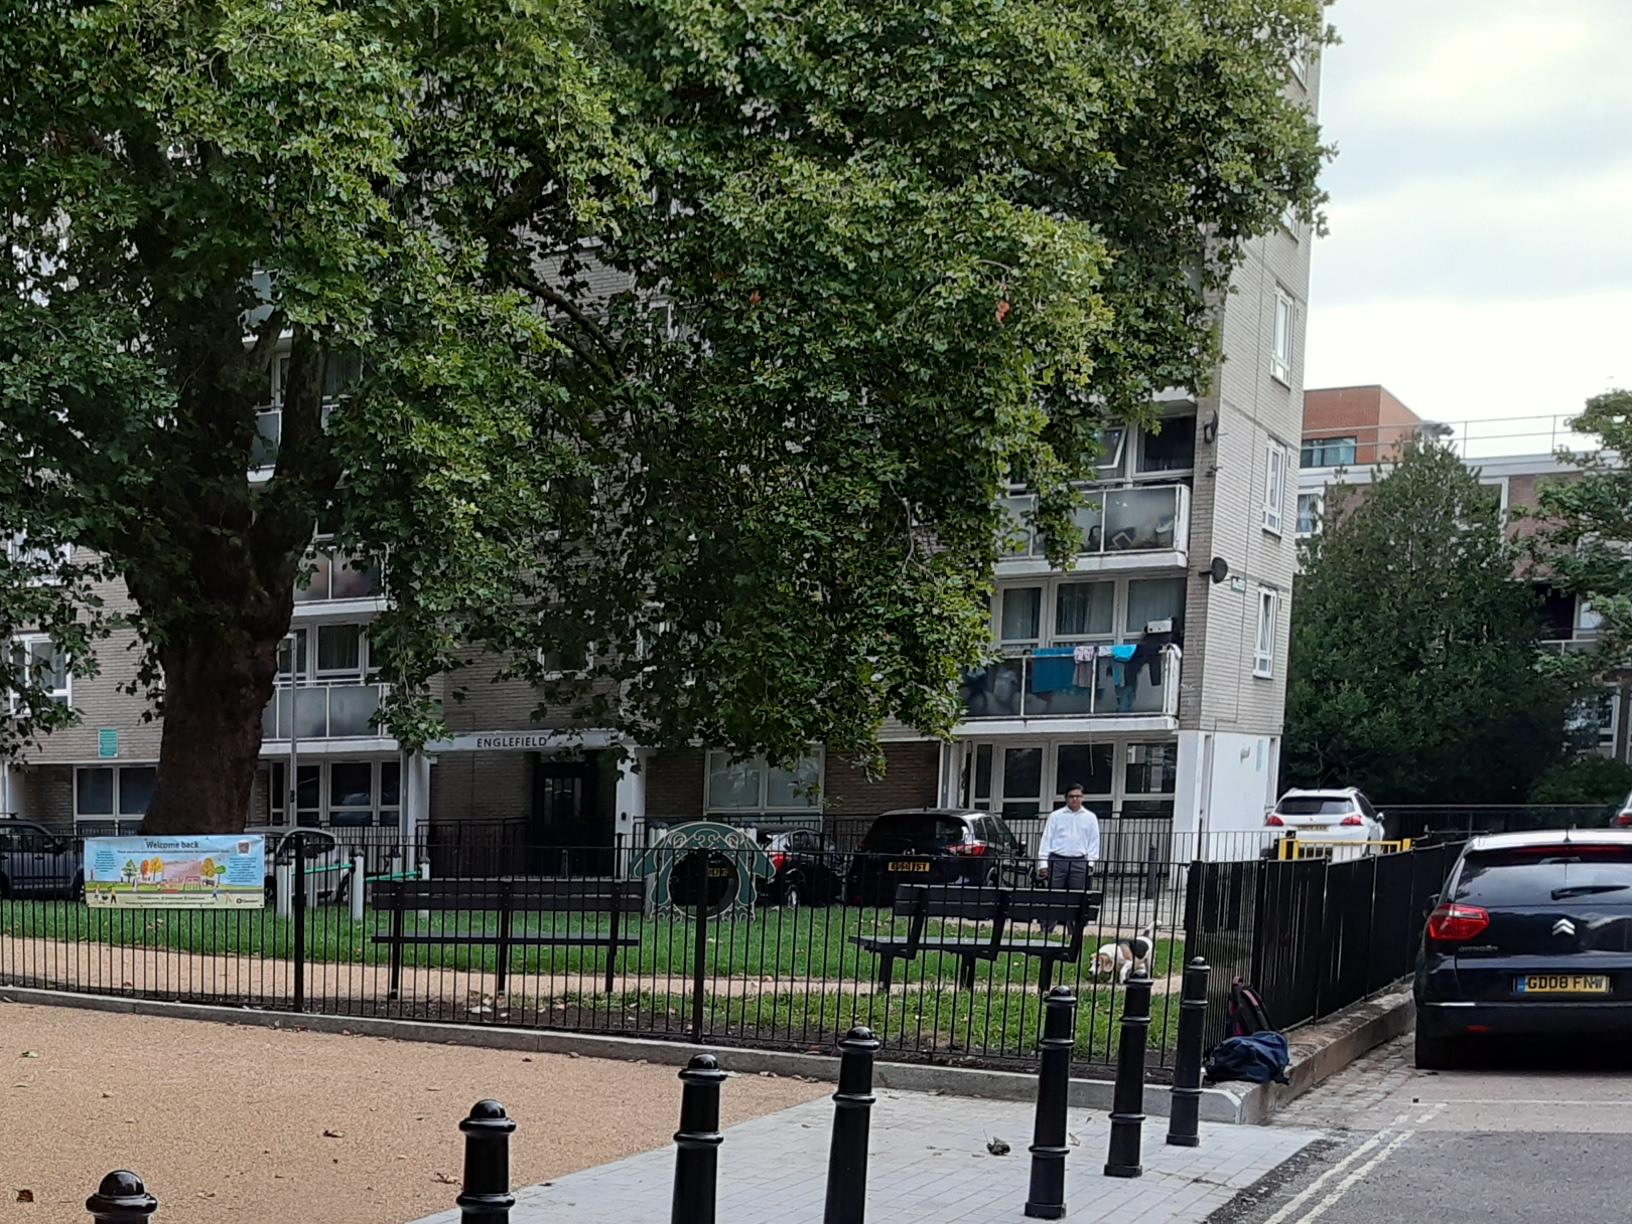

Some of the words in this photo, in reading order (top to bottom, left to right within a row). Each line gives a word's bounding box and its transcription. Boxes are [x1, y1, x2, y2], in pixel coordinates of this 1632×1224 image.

[477, 737, 547, 748] ENGLEFIELD
[146, 841, 180, 849] Welcome
[181, 841, 199, 849] back
[1528, 976, 1568, 989] GD08
